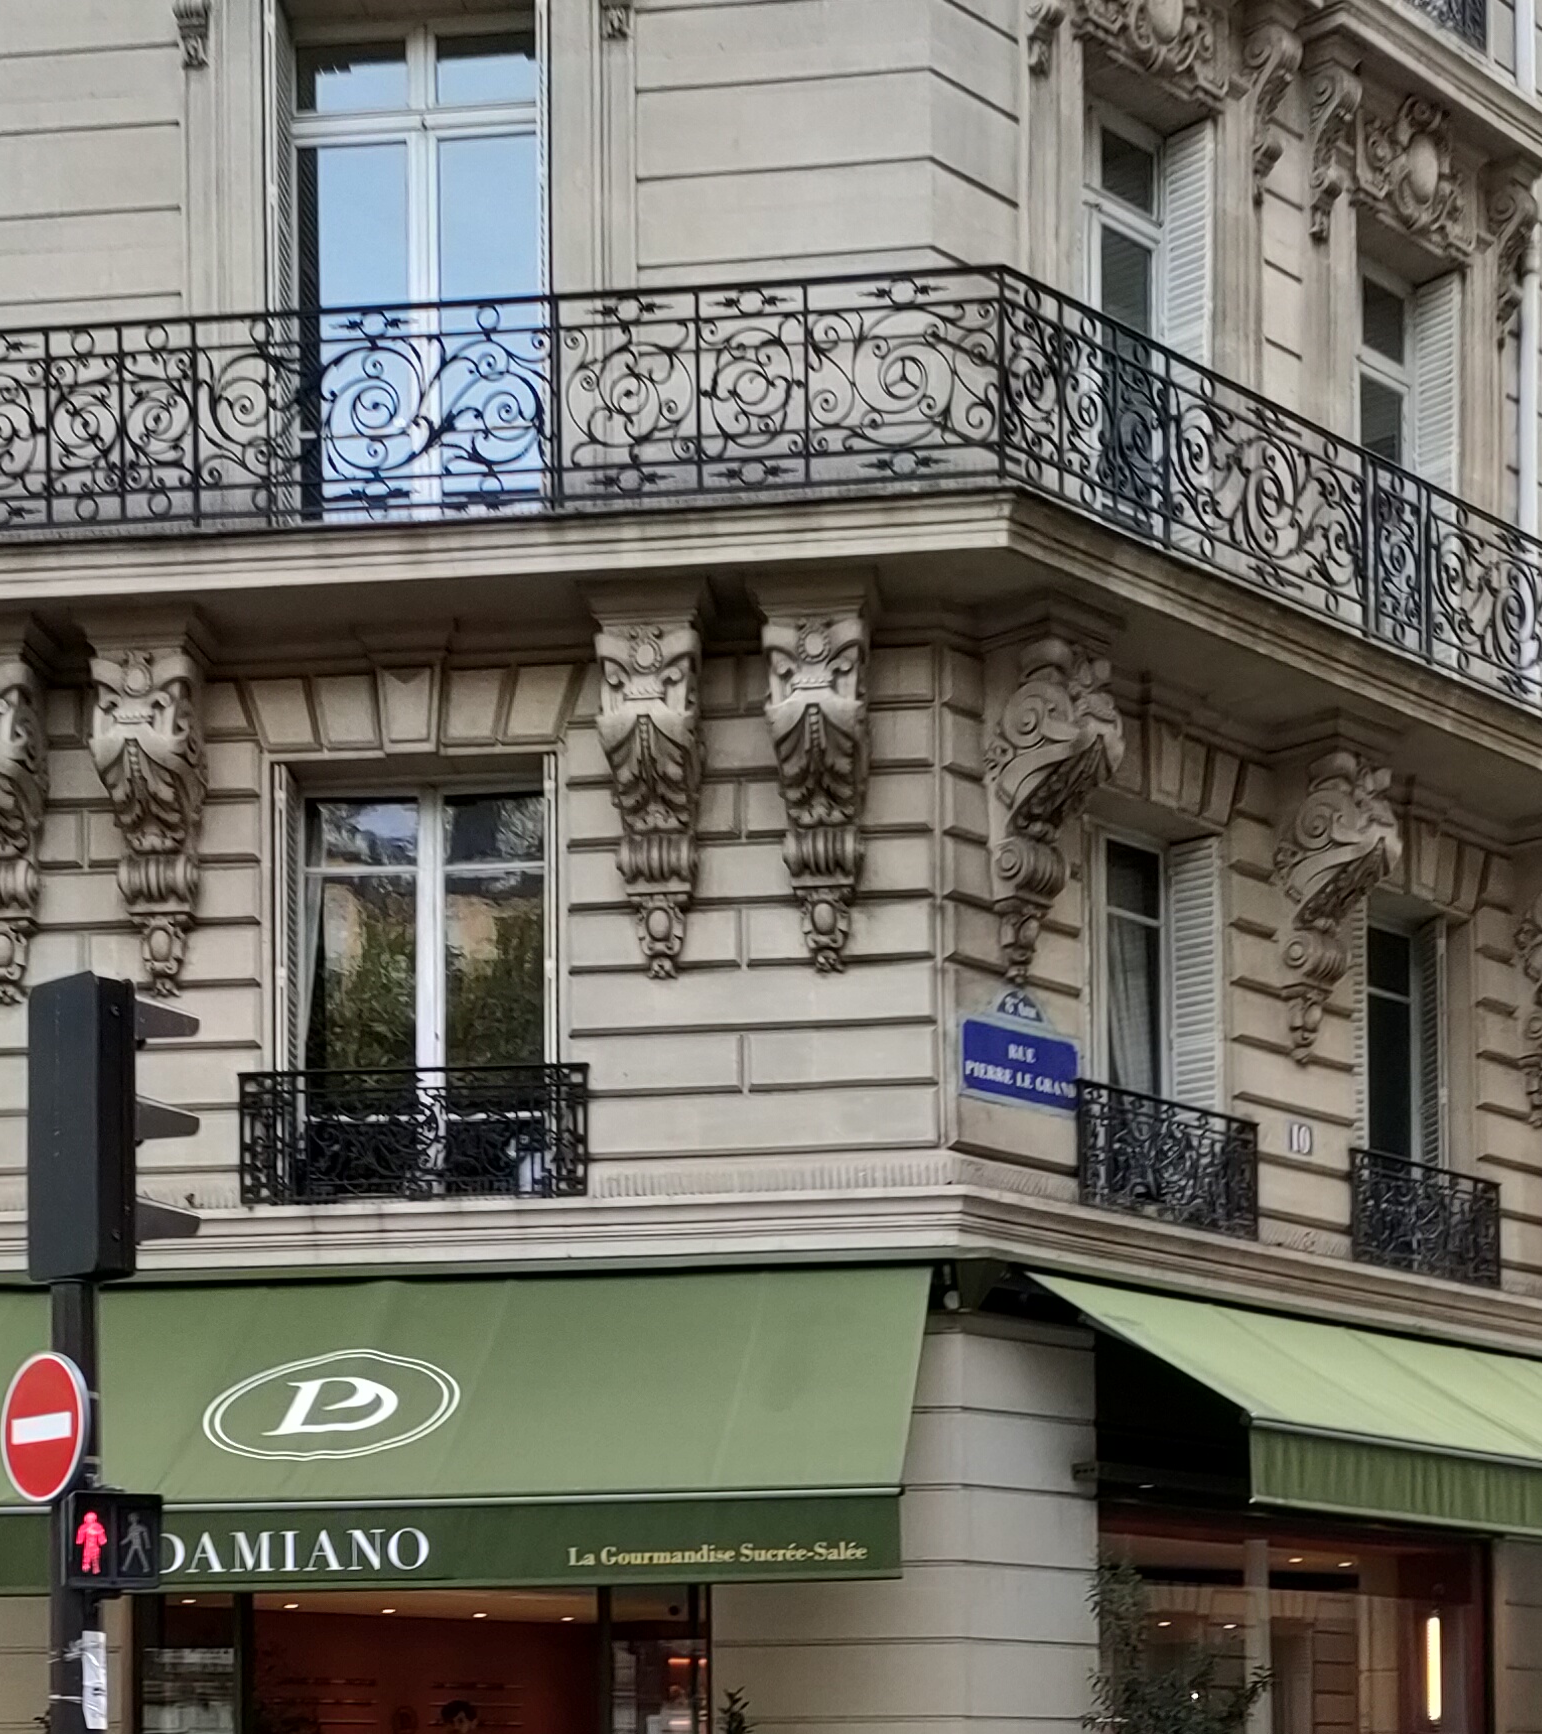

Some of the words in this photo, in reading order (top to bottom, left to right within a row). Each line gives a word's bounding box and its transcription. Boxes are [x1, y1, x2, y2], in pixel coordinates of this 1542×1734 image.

[1008, 1043, 1036, 1063] RUE
[964, 1059, 1013, 1085] PIERRE
[1016, 1071, 1034, 1089] LE
[1035, 1076, 1077, 1099] GRAND
[1291, 1123, 1310, 1154] 10
[567, 1547, 596, 1566] La
[600, 1544, 736, 1565] Gourmandise
[739, 1541, 868, 1562] Sucrée-Salée
